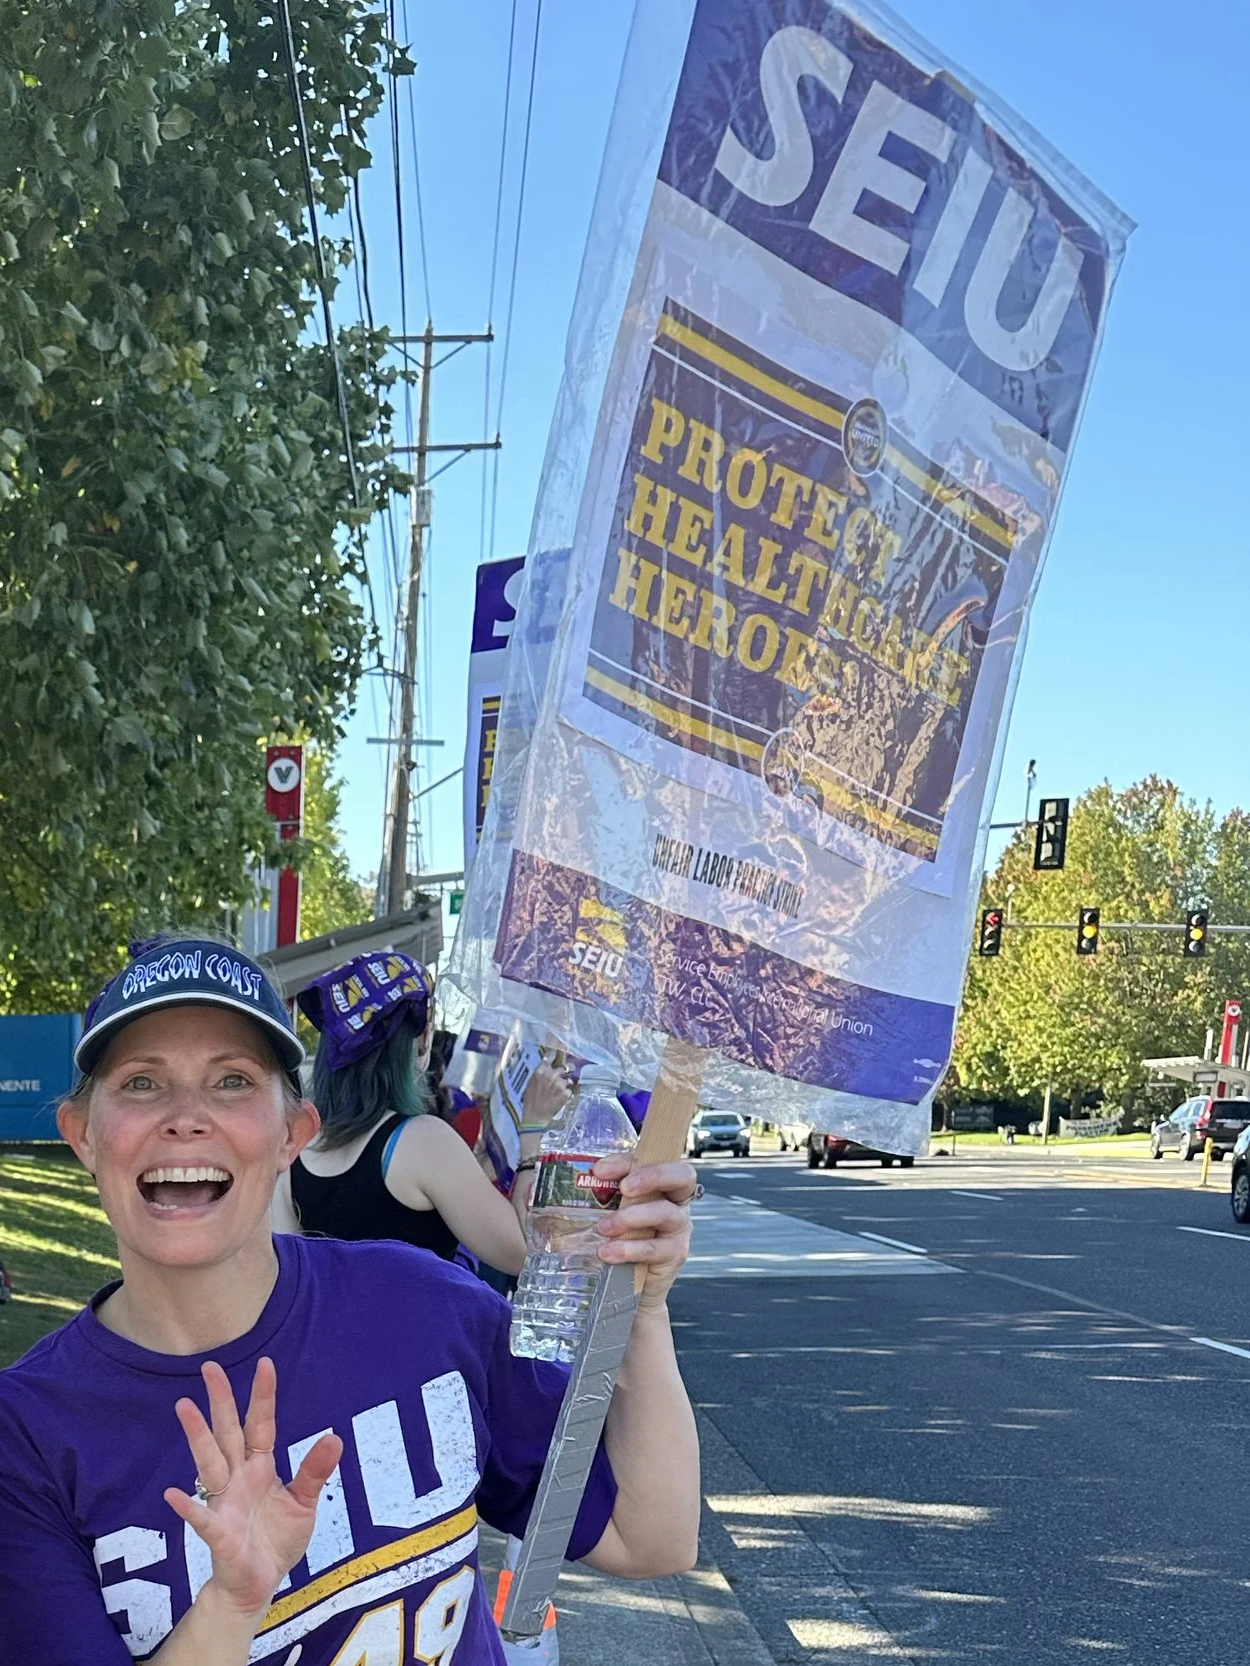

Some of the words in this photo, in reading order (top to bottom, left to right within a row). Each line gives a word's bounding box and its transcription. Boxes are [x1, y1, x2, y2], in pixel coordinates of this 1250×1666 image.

[715, 25, 1085, 372] SEIU
[640, 398, 902, 590] PROTECT
[653, 833, 694, 878] UNFAIR
[693, 848, 734, 891] LABOR
[122, 950, 201, 1000] OREGON
[205, 954, 261, 1000] COAST
[569, 941, 624, 978] SEIU
[830, 1011, 874, 1036] Union
